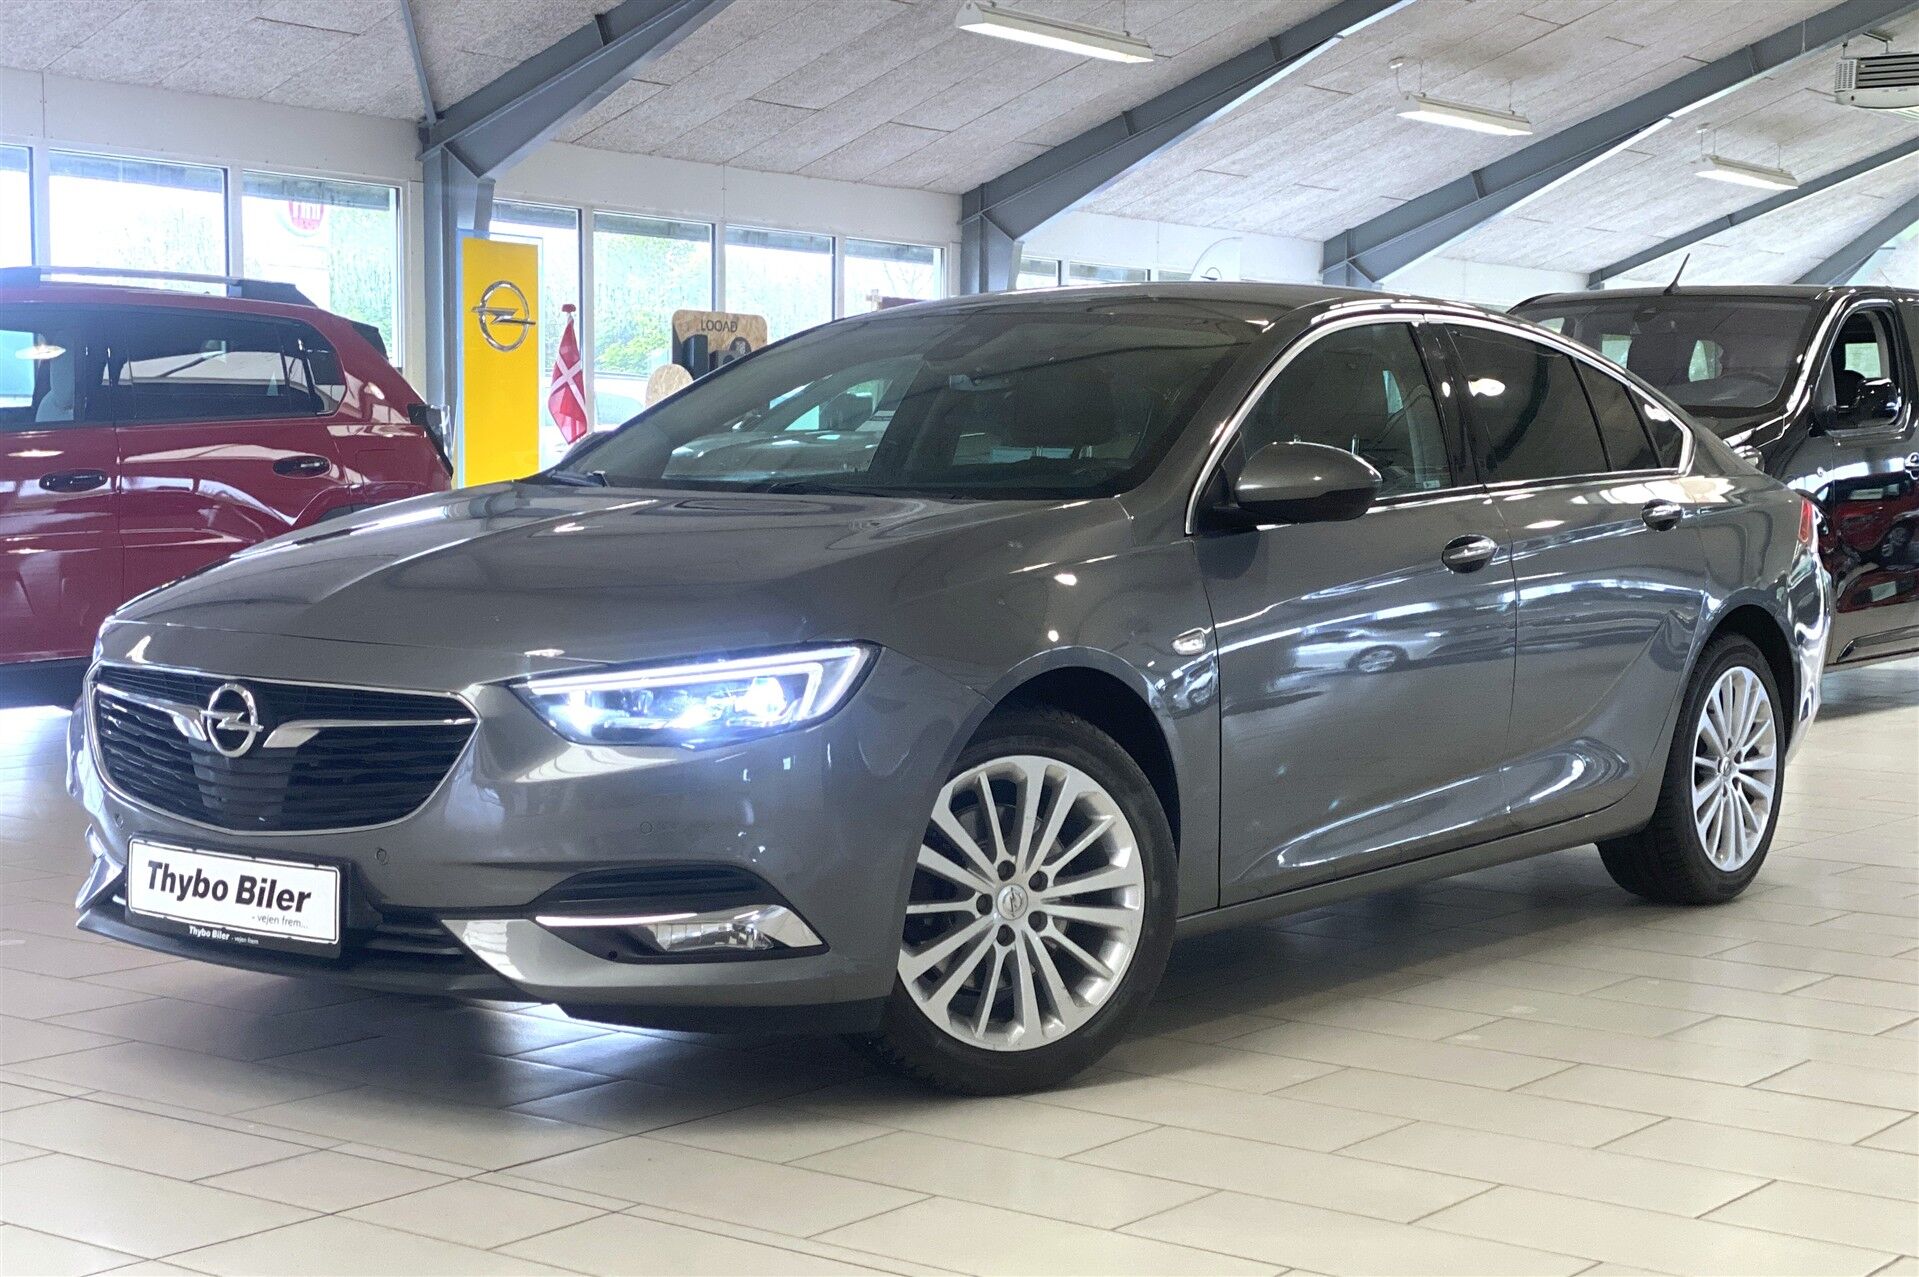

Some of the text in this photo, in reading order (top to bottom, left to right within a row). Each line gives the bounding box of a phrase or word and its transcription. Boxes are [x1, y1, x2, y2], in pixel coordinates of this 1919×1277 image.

[700, 319, 738, 333] LOOAD
[148, 860, 312, 913] Thybo Biler
[257, 914, 280, 926] vejen
[189, 925, 211, 938] Thybo
[211, 929, 230, 941] Biler
